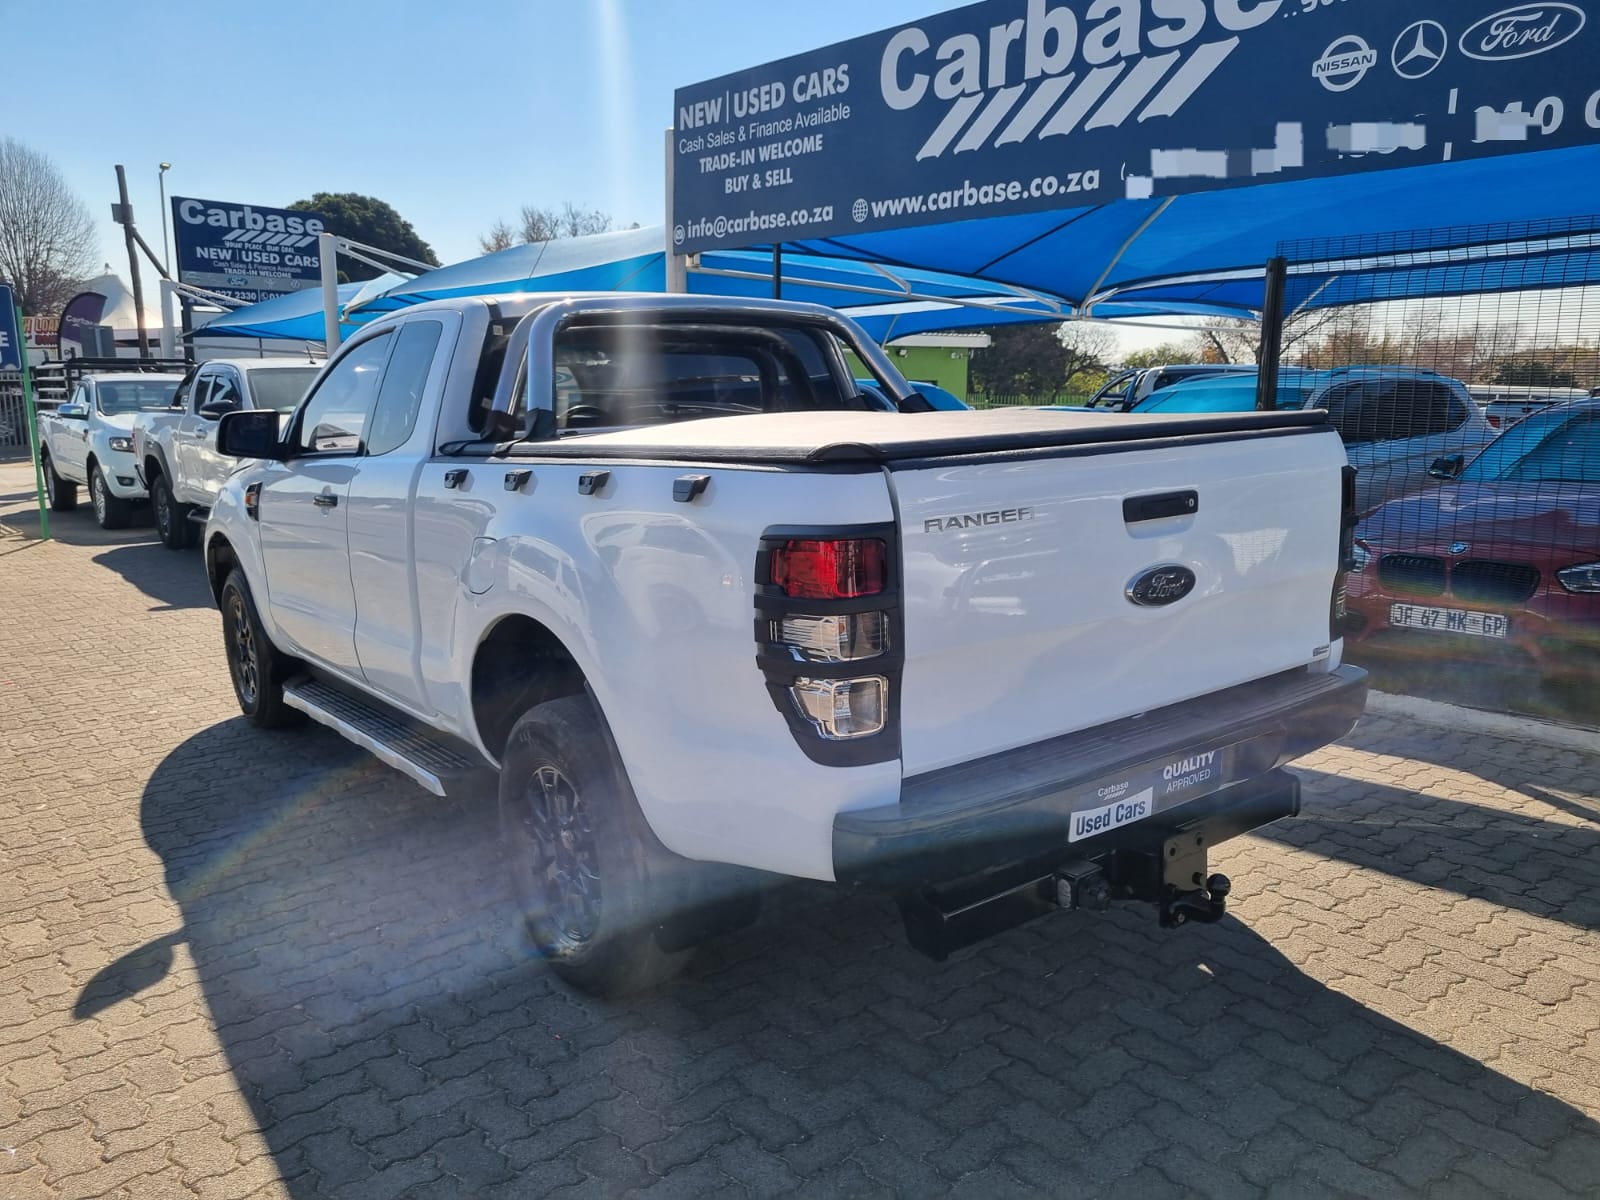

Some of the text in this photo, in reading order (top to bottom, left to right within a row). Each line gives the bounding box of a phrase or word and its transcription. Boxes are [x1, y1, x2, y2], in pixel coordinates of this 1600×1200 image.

[1480, 11, 1557, 51] Ford
[1316, 54, 1373, 74] NISSAN
[679, 64, 850, 131] NEW USED CARS
[679, 103, 851, 154] Cash Sales & Finance Available
[700, 134, 823, 173] TRADE-IN WELCOME
[725, 168, 793, 194] BUY & SELL
[871, 169, 1100, 218] www.carbase.co.za
[180, 200, 324, 236] Carbase
[687, 205, 833, 238] info@carbase.co.za
[196, 246, 320, 268] NEW USED CARS
[224, 267, 292, 279] TRADE-IN WELCOME
[924, 507, 1034, 533] RANGER
[1148, 571, 1185, 598] Ford
[1421, 608, 1440, 627] 67
[1447, 610, 1466, 630] MK
[1482, 615, 1504, 635] GP
[1163, 750, 1216, 780] QUALITY
[1097, 781, 1129, 797] Carbase
[1166, 768, 1211, 794] APPROVED
[1076, 801, 1146, 836] Used Cars
